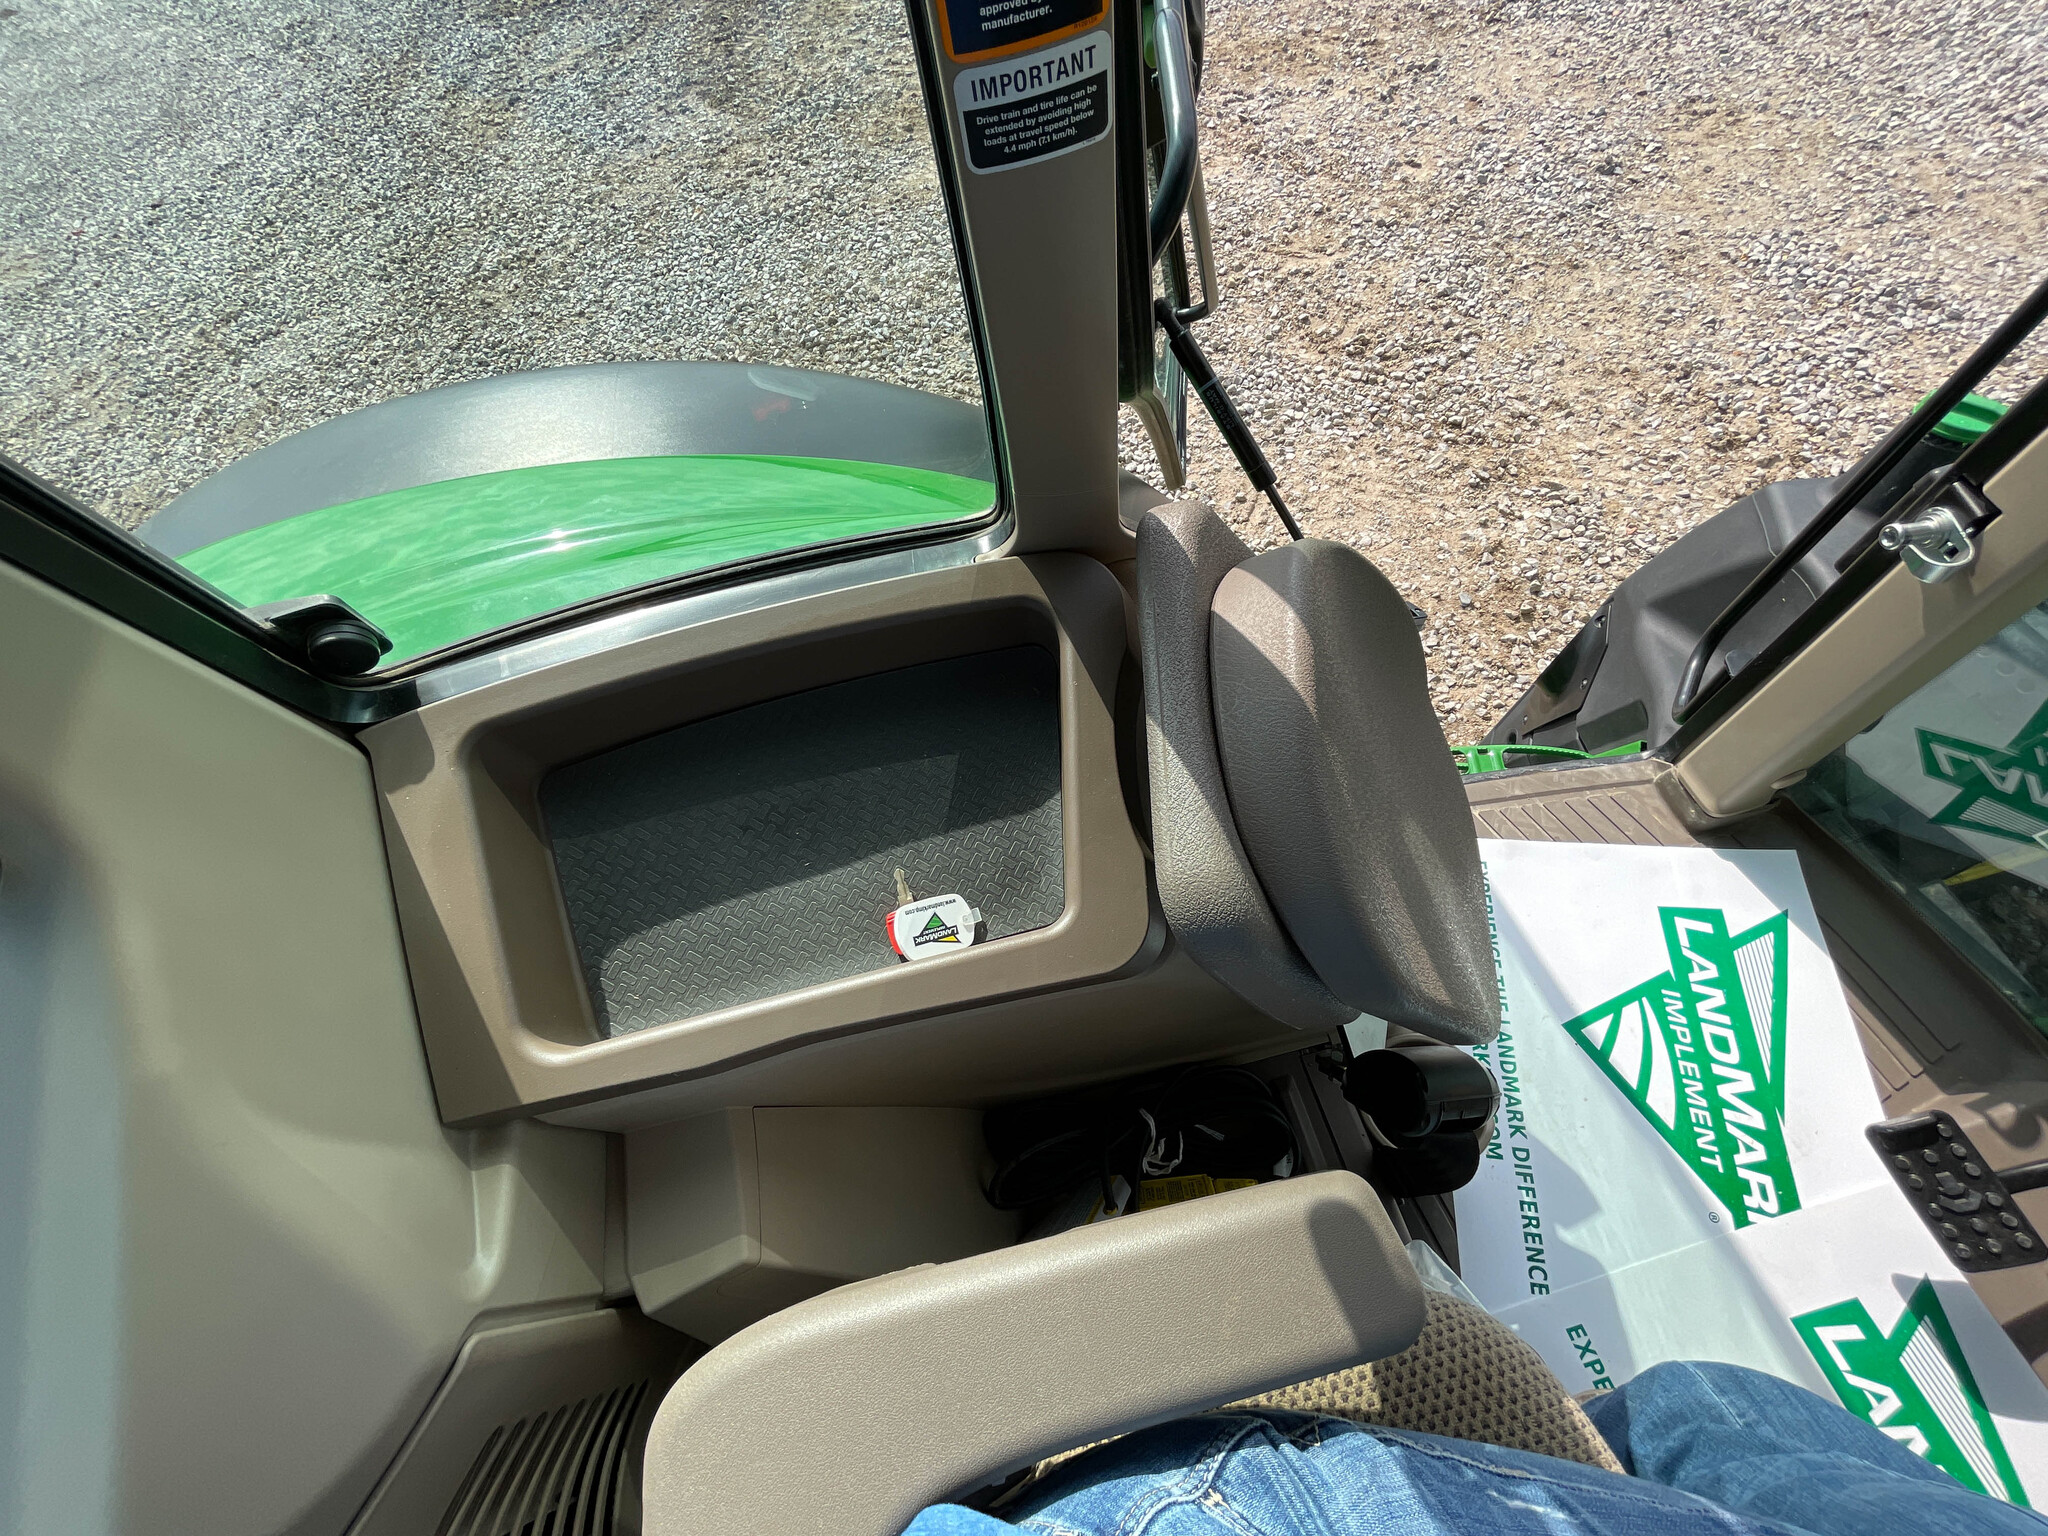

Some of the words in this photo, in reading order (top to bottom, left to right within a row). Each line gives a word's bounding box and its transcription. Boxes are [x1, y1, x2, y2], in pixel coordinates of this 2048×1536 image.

[979, 0, 1028, 17] approved
[981, 5, 1053, 31] manufacturer.
[971, 45, 1097, 102] IMPORTANT
[976, 114, 999, 125] Drive
[1001, 108, 1020, 120] train
[1022, 104, 1039, 115] and
[1040, 100, 1055, 111] tire
[1055, 94, 1069, 105] life
[1070, 89, 1086, 100] can
[1087, 84, 1097, 94] be
[984, 120, 1024, 135] extended
[1025, 117, 1037, 127] by
[1038, 106, 1073, 123] avoiding
[1074, 97, 1092, 111] high
[983, 134, 1007, 147] loads
[1008, 131, 1018, 142] at
[1019, 126, 1043, 139] travel
[1044, 117, 1069, 133] speed
[1070, 108, 1095, 123] below
[1003, 143, 1016, 154] 4.4
[1018, 138, 1037, 151] mph
[1052, 126, 1078, 141] km/h).
[915, 926, 958, 943] LANDMARK
[1661, 988, 1724, 1174] IMPLEMENT
[1511, 1146, 1550, 1297] DIFFERENCE
